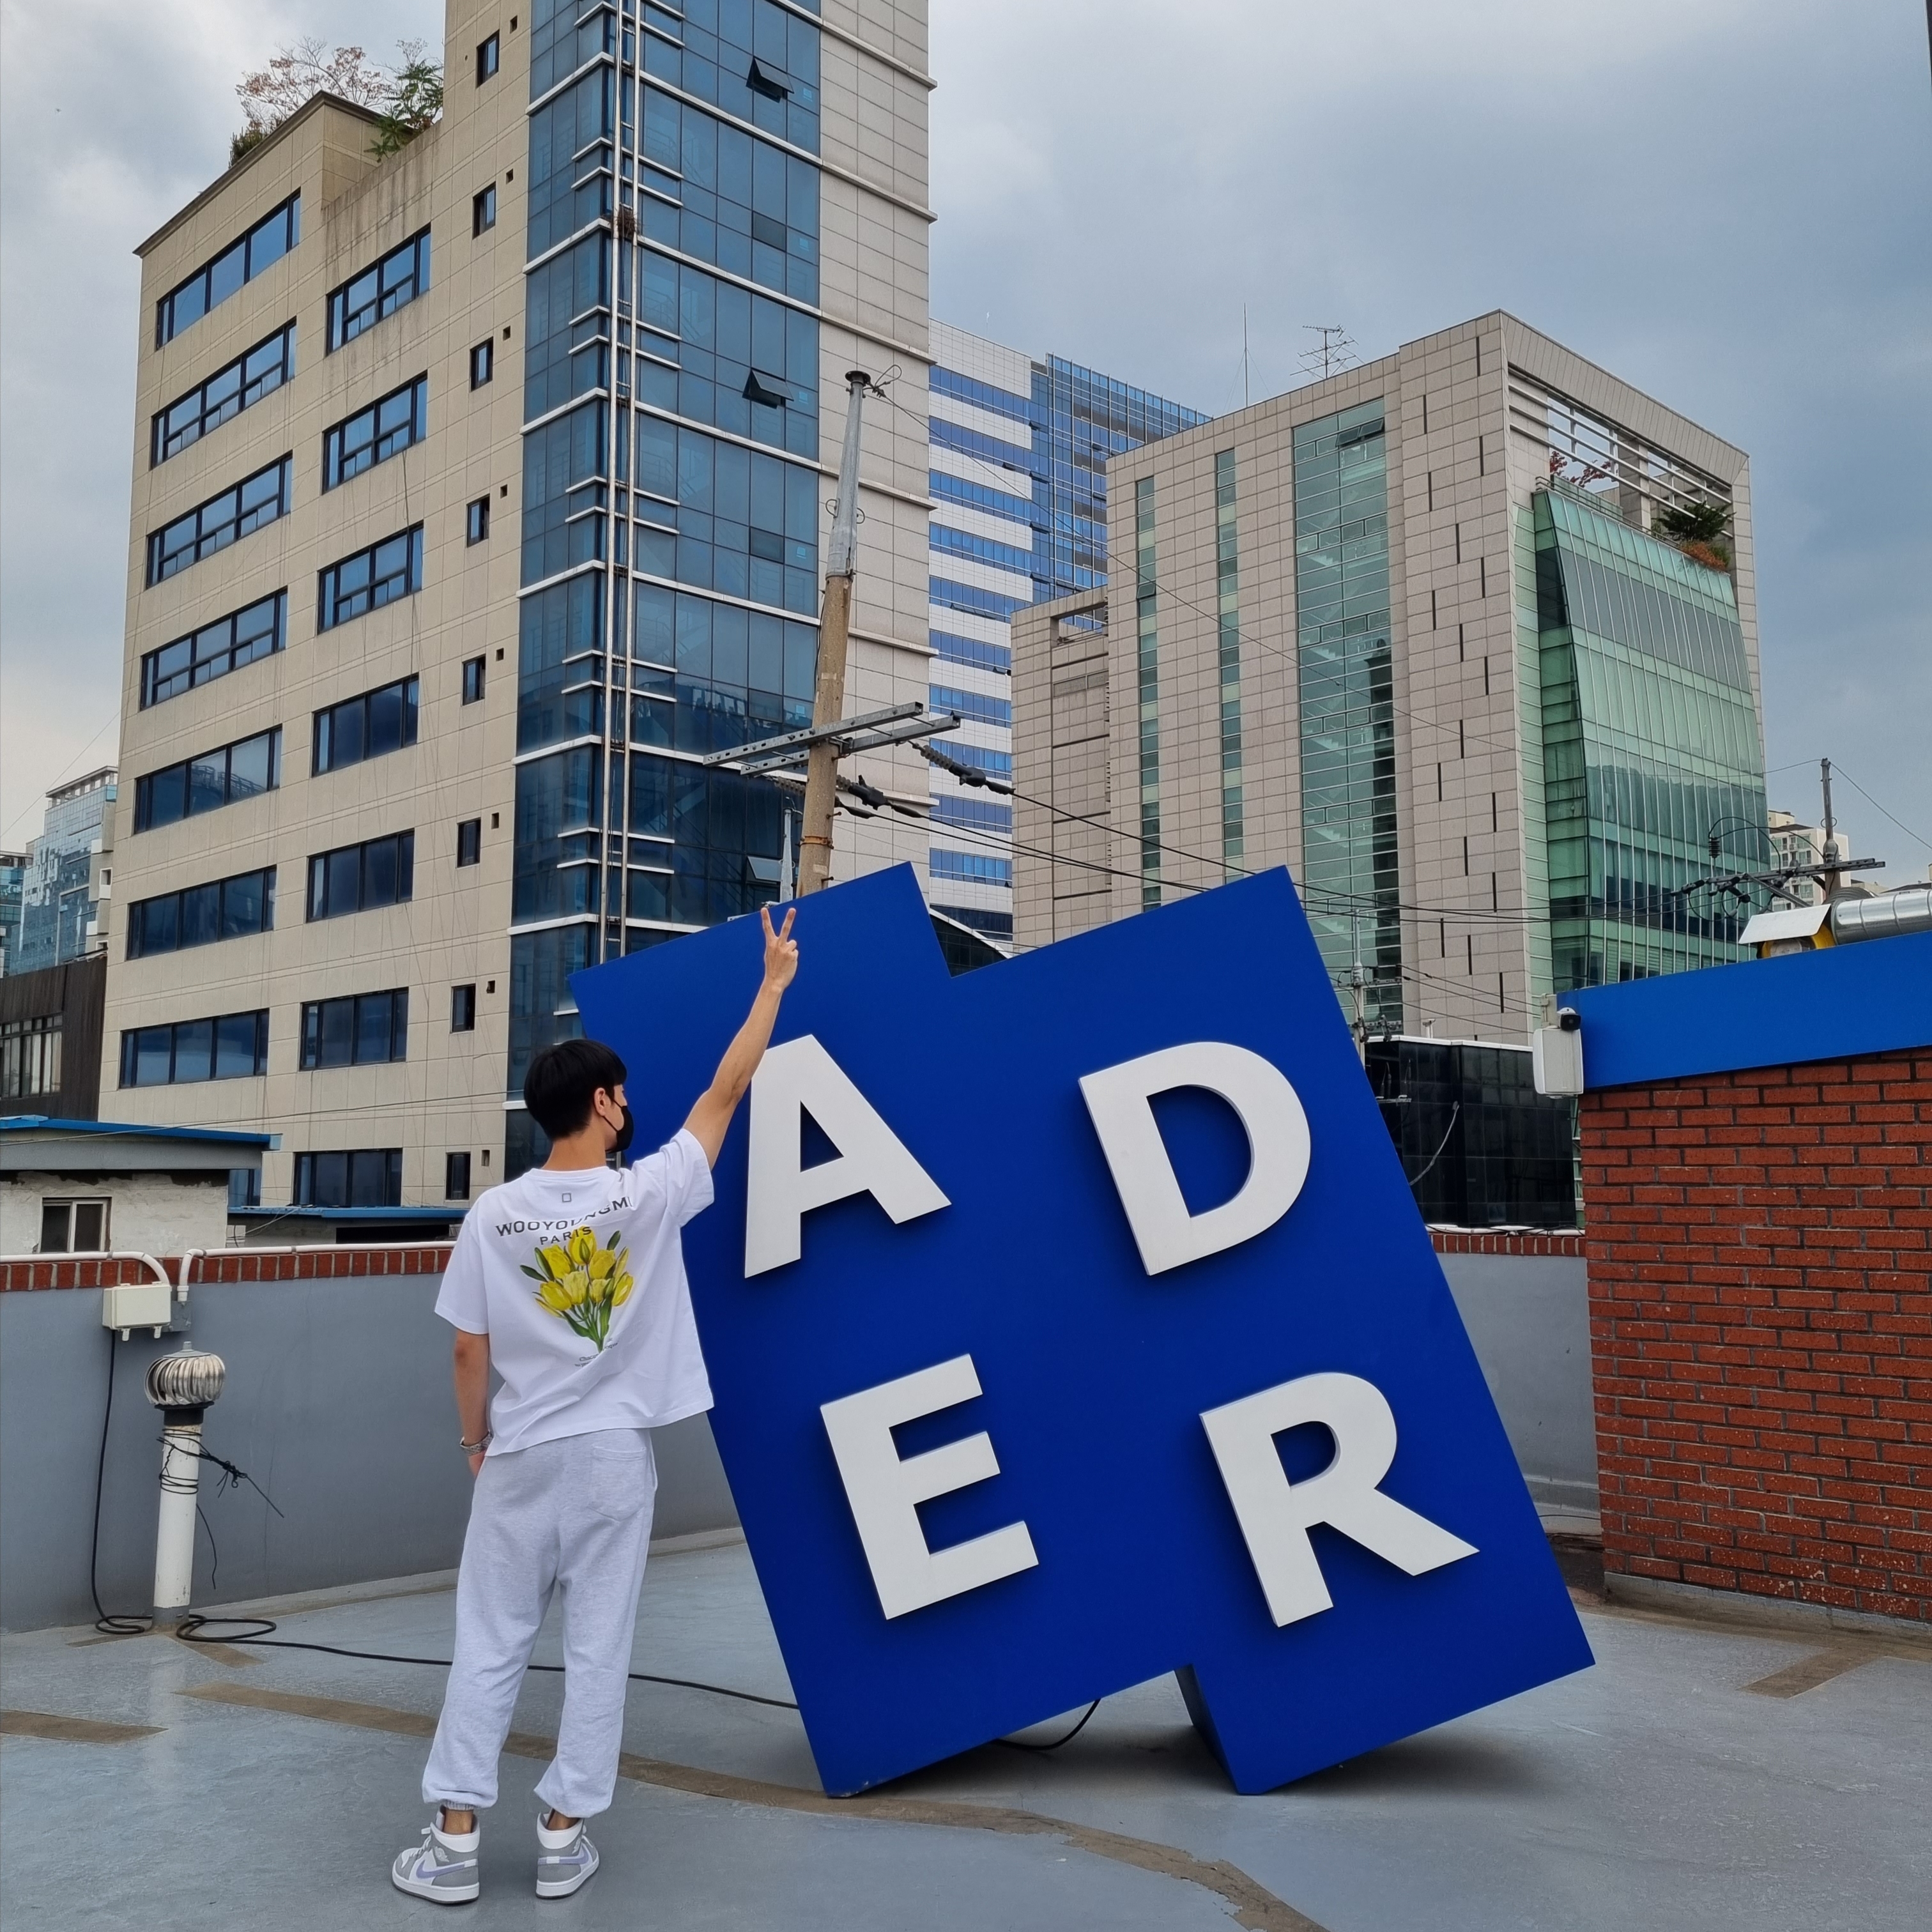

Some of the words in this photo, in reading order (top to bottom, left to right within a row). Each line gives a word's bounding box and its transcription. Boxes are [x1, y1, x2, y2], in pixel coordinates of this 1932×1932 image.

[539, 1227, 592, 1245] PARIS
[745, 1035, 951, 1278] A
[1080, 1042, 1311, 1276] D
[820, 1354, 1038, 1620] E
[1200, 1373, 1479, 1627] R
